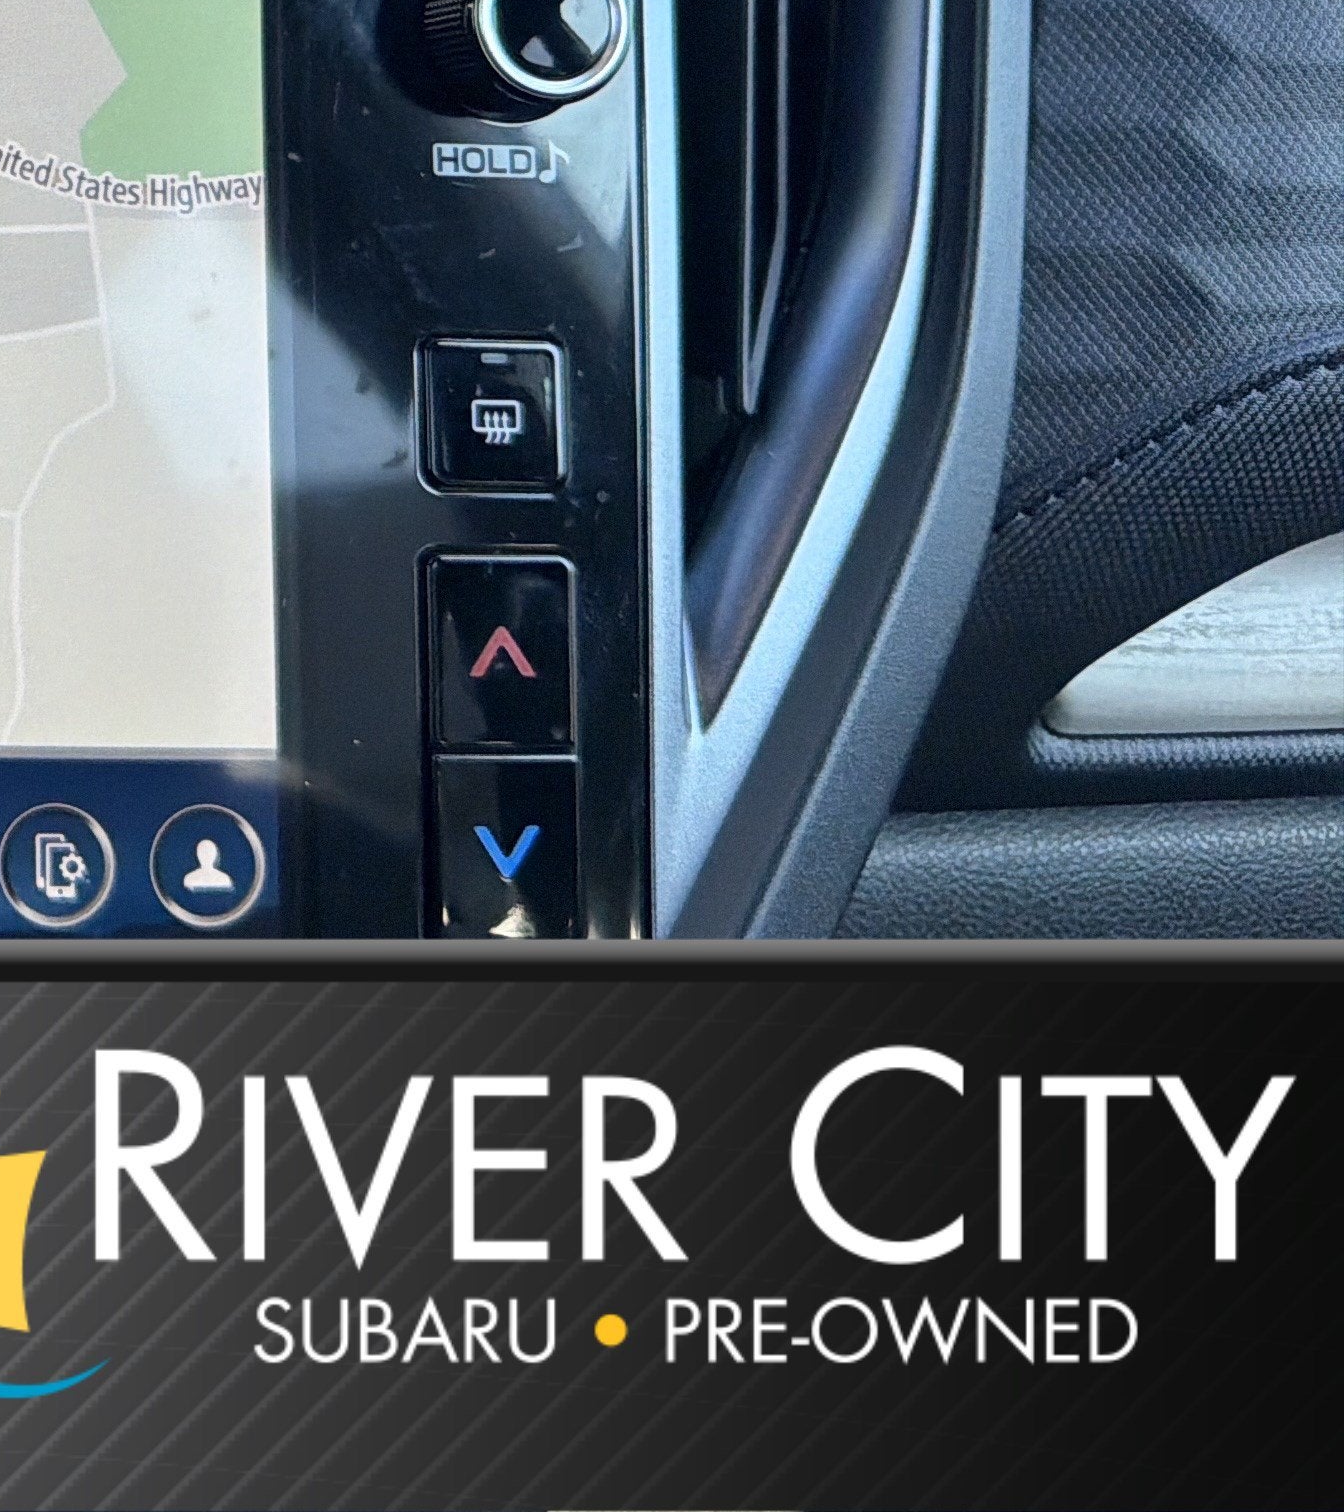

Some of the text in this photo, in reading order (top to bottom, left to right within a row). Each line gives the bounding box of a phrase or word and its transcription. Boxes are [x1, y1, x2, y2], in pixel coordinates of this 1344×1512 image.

[435, 146, 533, 176] HOLD
[59, 165, 141, 205] States
[149, 174, 263, 214] Highway
